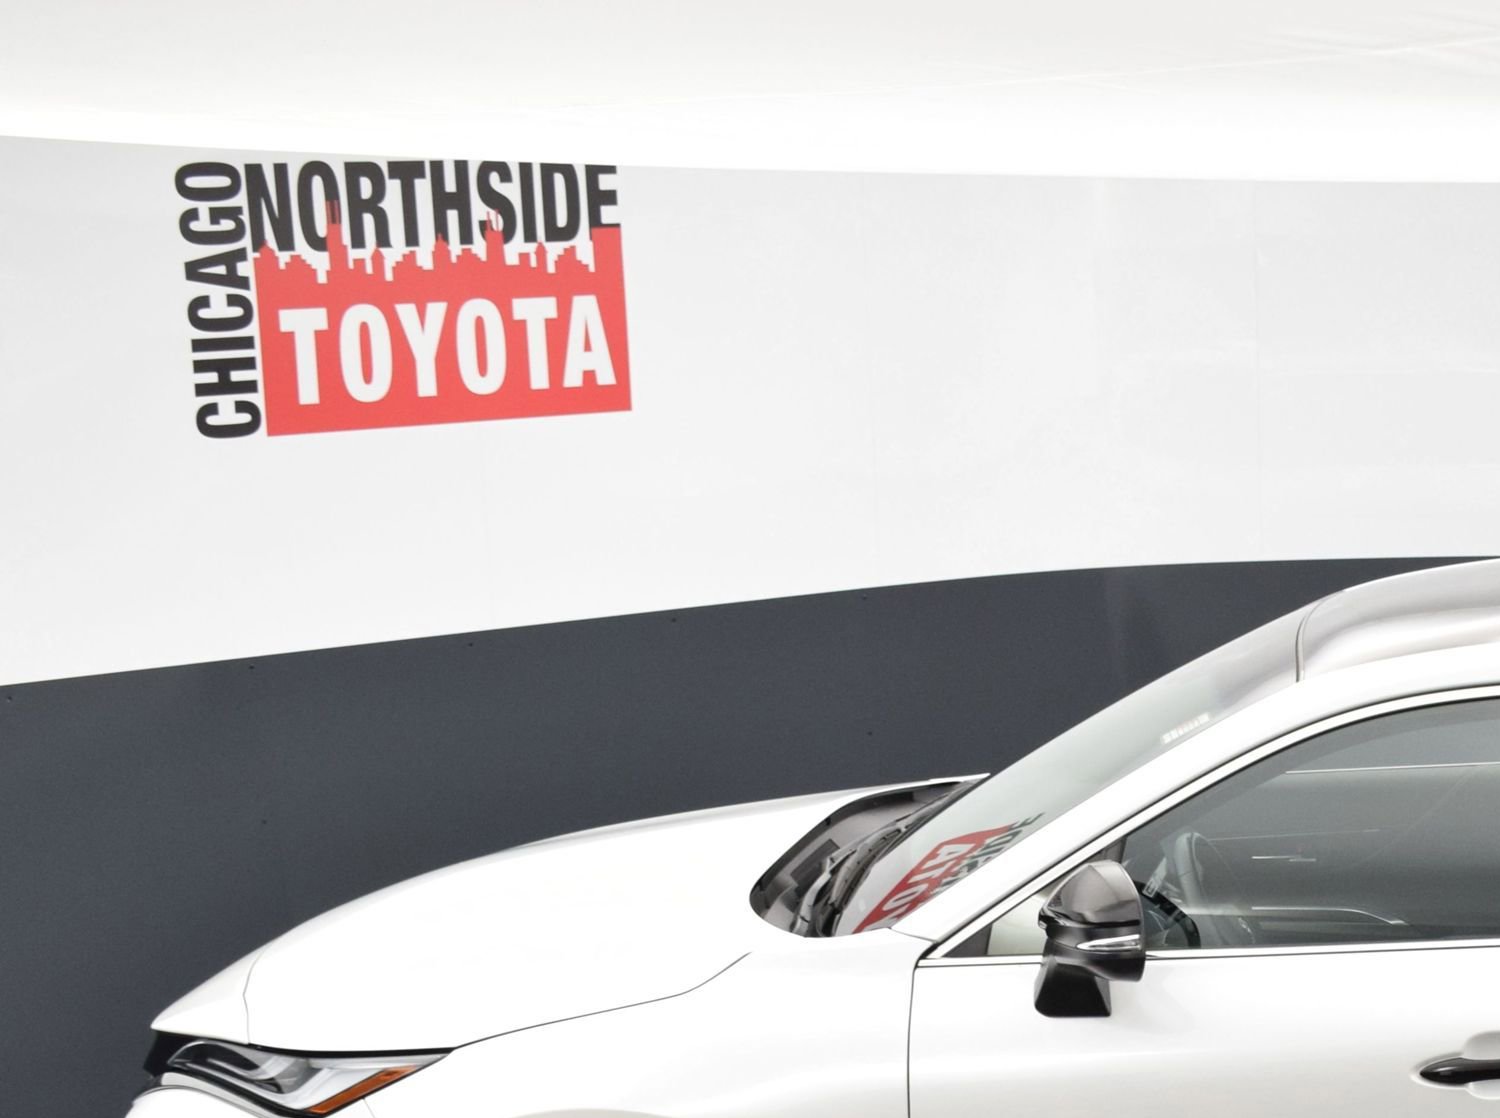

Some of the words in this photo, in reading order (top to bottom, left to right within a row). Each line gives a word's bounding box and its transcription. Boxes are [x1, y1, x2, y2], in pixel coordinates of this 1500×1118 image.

[243, 159, 621, 252] NORTHSIDE
[174, 161, 262, 439] CHICAGO
[278, 294, 617, 405] TOYOTA
